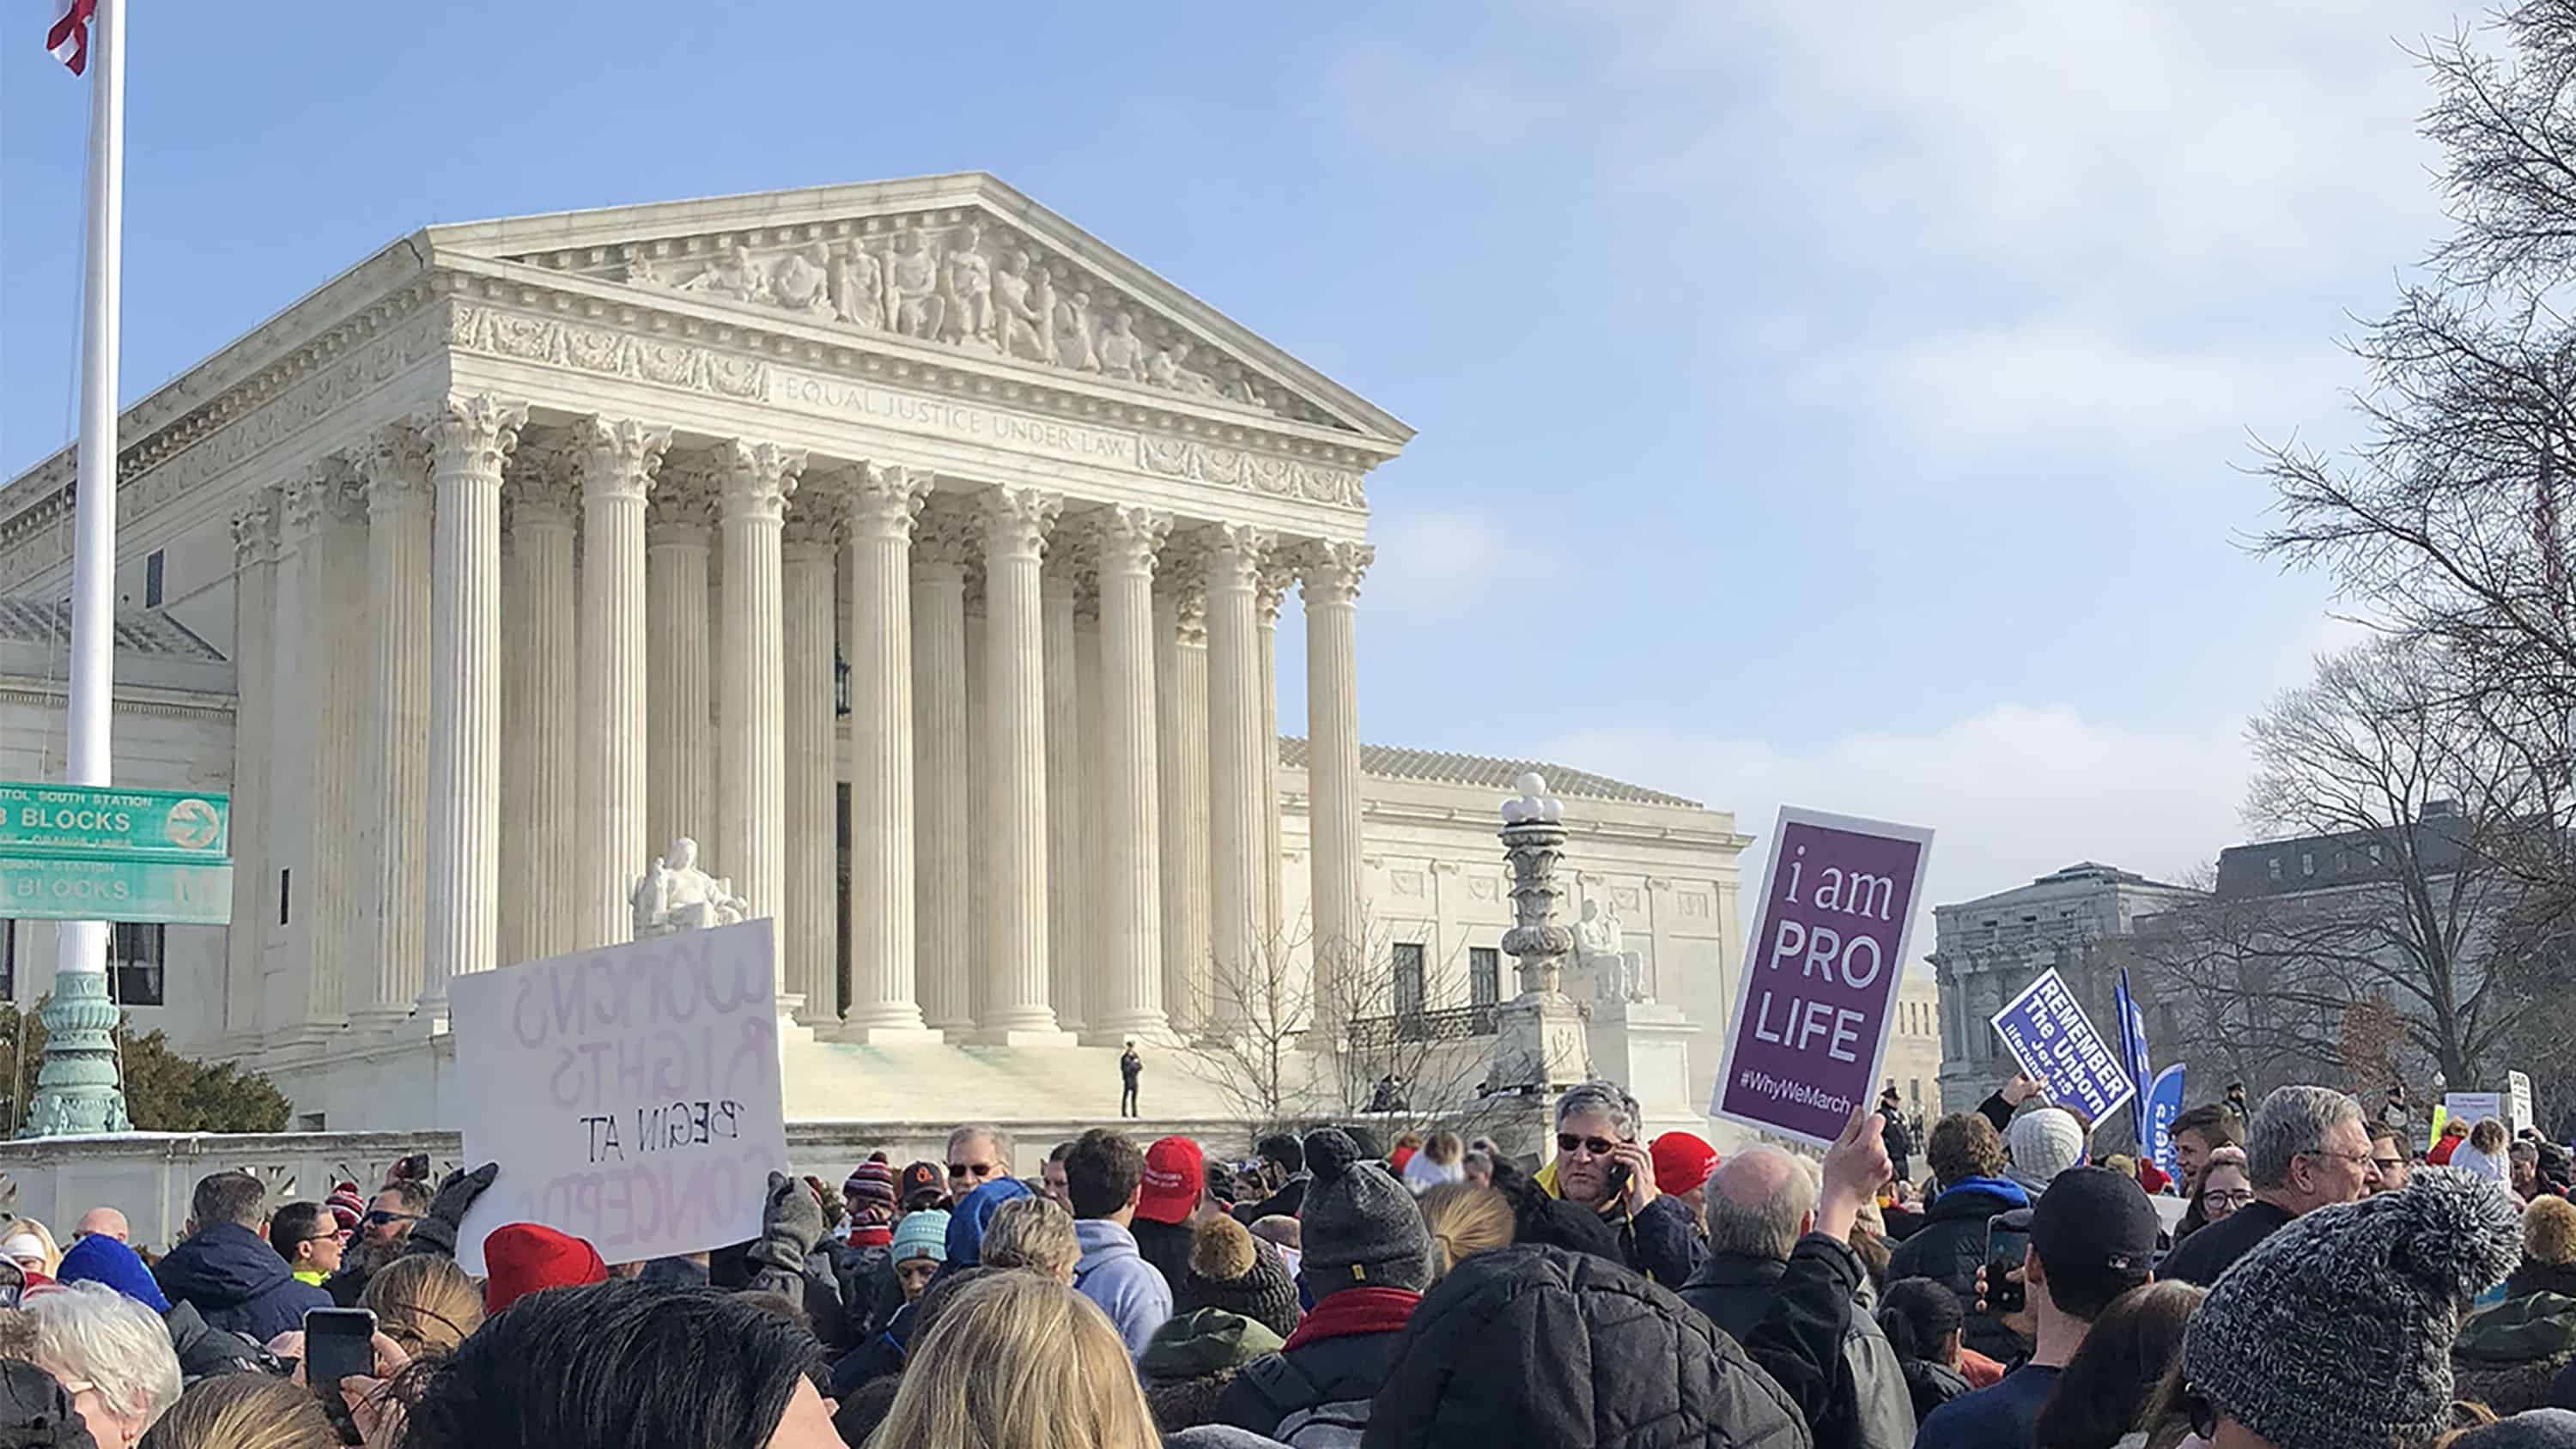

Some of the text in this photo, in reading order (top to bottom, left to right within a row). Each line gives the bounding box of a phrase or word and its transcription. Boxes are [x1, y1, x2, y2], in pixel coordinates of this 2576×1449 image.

[785, 376, 1127, 457] EQUAL JUSTICE UNDER LAW
[21, 807, 131, 832] BLOCKS
[38, 791, 85, 804] SOUTH
[93, 794, 152, 807] STATION
[1785, 846, 1895, 922] i am
[1770, 919, 1883, 989] PRO
[1754, 991, 1865, 1063] LIFE
[2025, 993, 2106, 1114] The Unborn
[2039, 979, 2124, 1100] REMEMBER
[1740, 1069, 1851, 1115] #WhyWeMarch
[2053, 1068, 2075, 1096] 1:5
